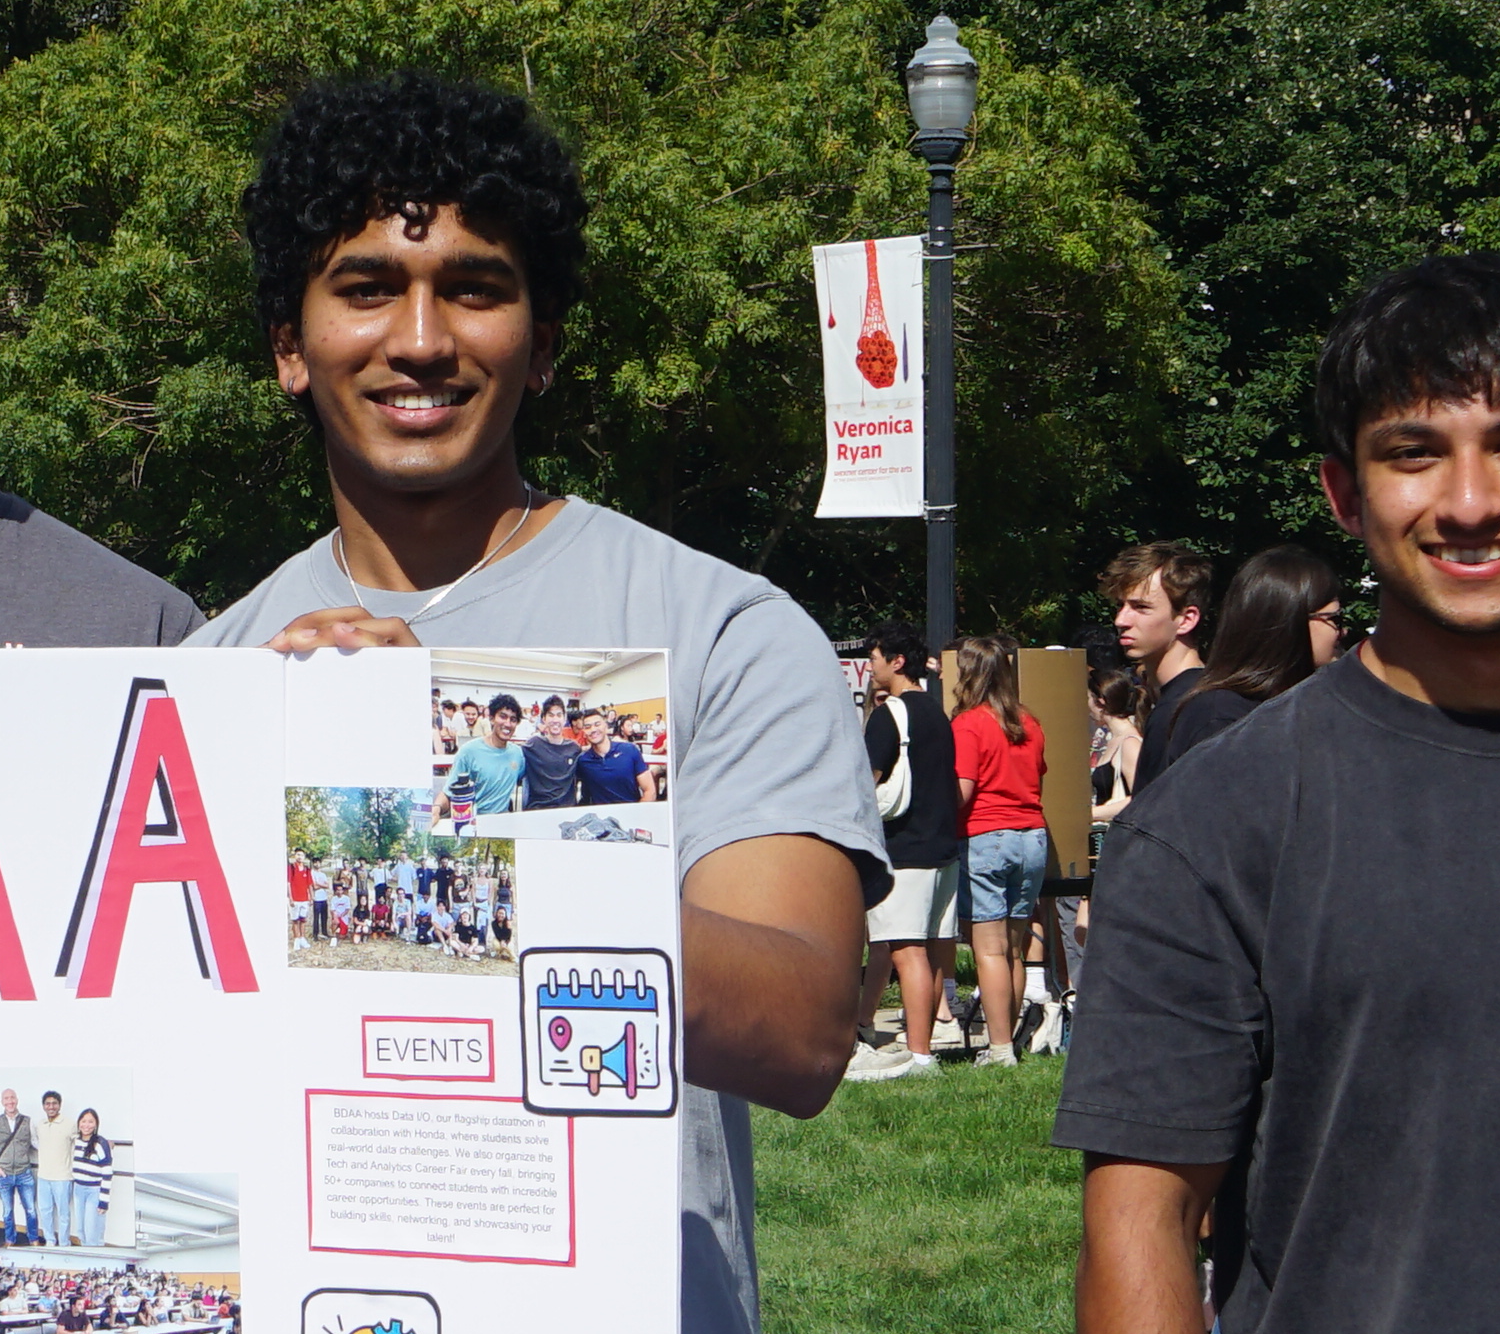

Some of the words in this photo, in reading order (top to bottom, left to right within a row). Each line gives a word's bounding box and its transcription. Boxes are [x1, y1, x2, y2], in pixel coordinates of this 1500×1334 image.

[833, 415, 913, 438] Veronica
[837, 444, 882, 465] Ryan
[376, 1037, 483, 1063] EVENTS
[334, 1108, 363, 1118] BDAA
[364, 1110, 389, 1120] hosts
[392, 1111, 414, 1121] Data
[436, 1115, 451, 1123] our
[454, 1114, 490, 1126] flagship
[492, 1114, 535, 1127] datathon
[538, 1115, 546, 1127] in
